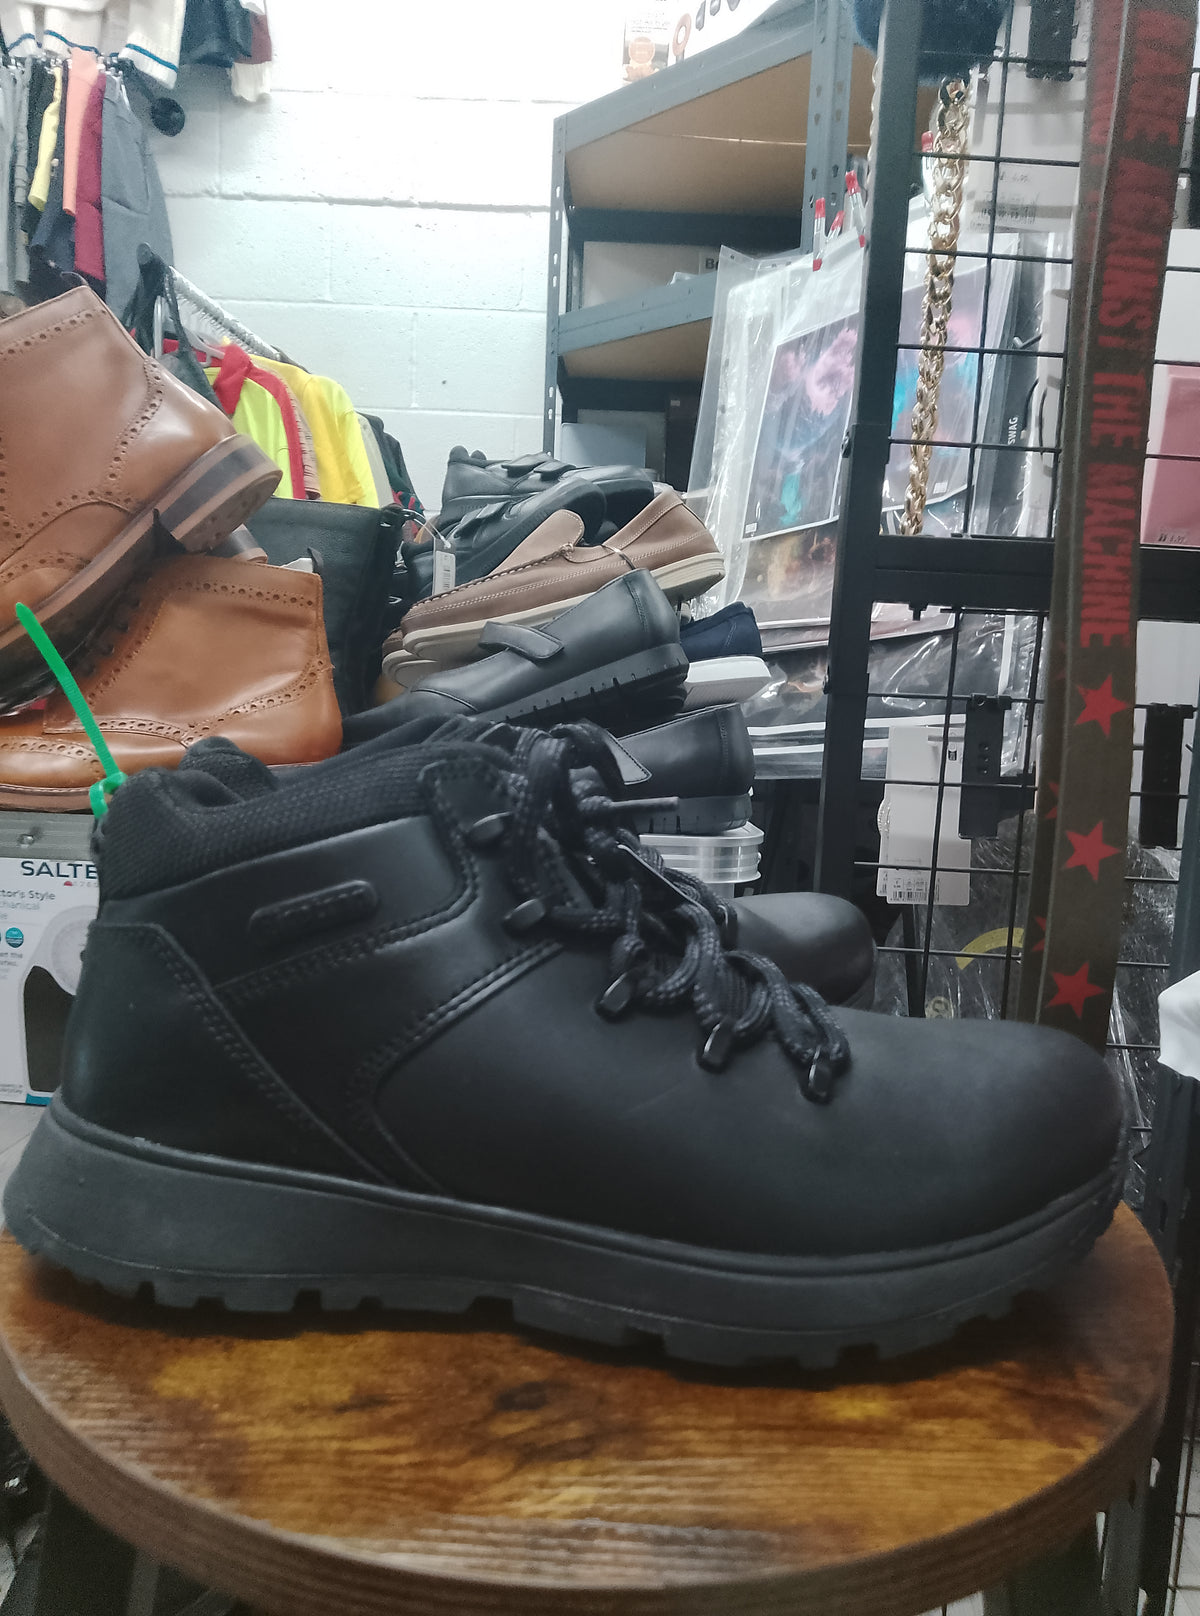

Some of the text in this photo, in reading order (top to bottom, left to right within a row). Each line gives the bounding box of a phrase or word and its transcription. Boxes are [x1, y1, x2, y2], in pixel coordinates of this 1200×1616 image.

[1008, 416, 1018, 445] SWAG
[1090, 370, 1148, 448] THE
[1080, 462, 1138, 648] MACHINE
[28, 890, 56, 901] Style
